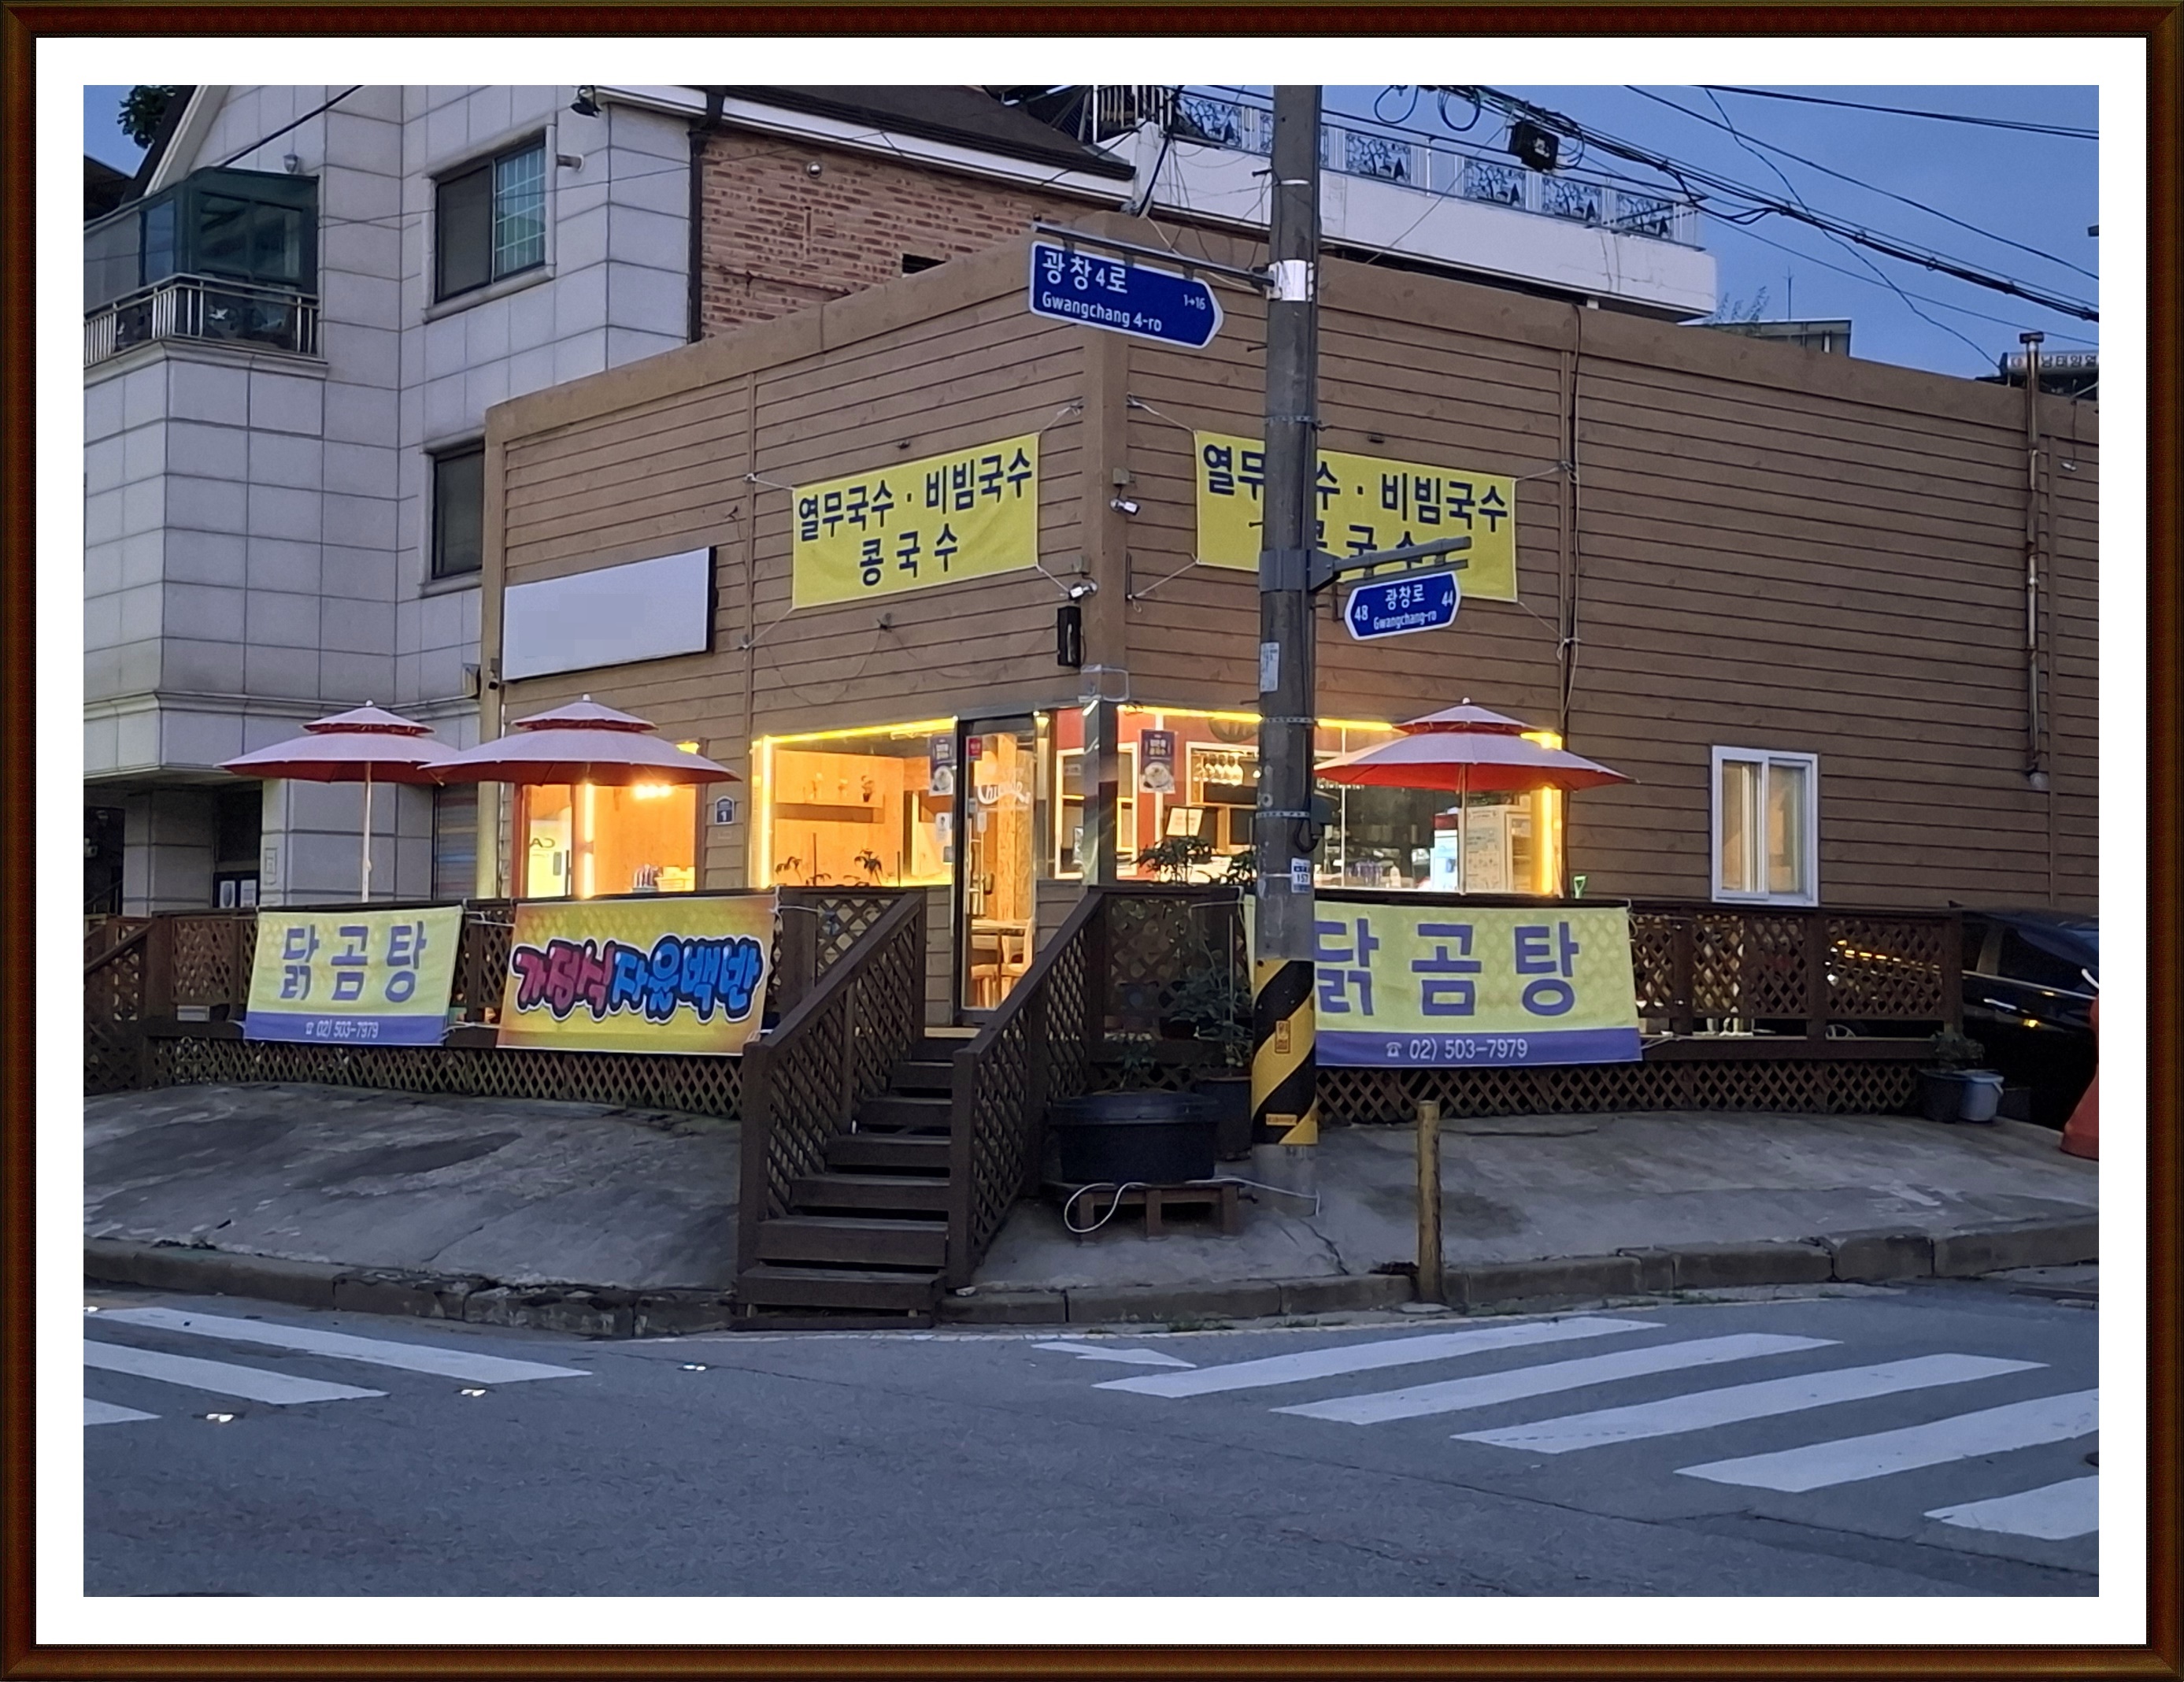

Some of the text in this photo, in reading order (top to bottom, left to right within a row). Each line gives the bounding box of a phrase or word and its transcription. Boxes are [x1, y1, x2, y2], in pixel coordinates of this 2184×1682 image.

[1042, 250, 1127, 295] 광창4로
[1042, 291, 1162, 332] Gwangchang 4-ro
[798, 447, 1032, 542] 열무국수 비빔국수
[1203, 443, 1508, 532] 열무수 비빔국수
[1385, 584, 1425, 610] 광창로
[1442, 590, 1453, 607] 44
[1354, 605, 1368, 621] 48
[1373, 610, 1438, 630] Gwangchang-ro
[279, 920, 427, 1003] 닭곰탕
[334, 1021, 379, 1039] 503-7979
[1409, 1038, 1528, 1061] 02) 503-7979
